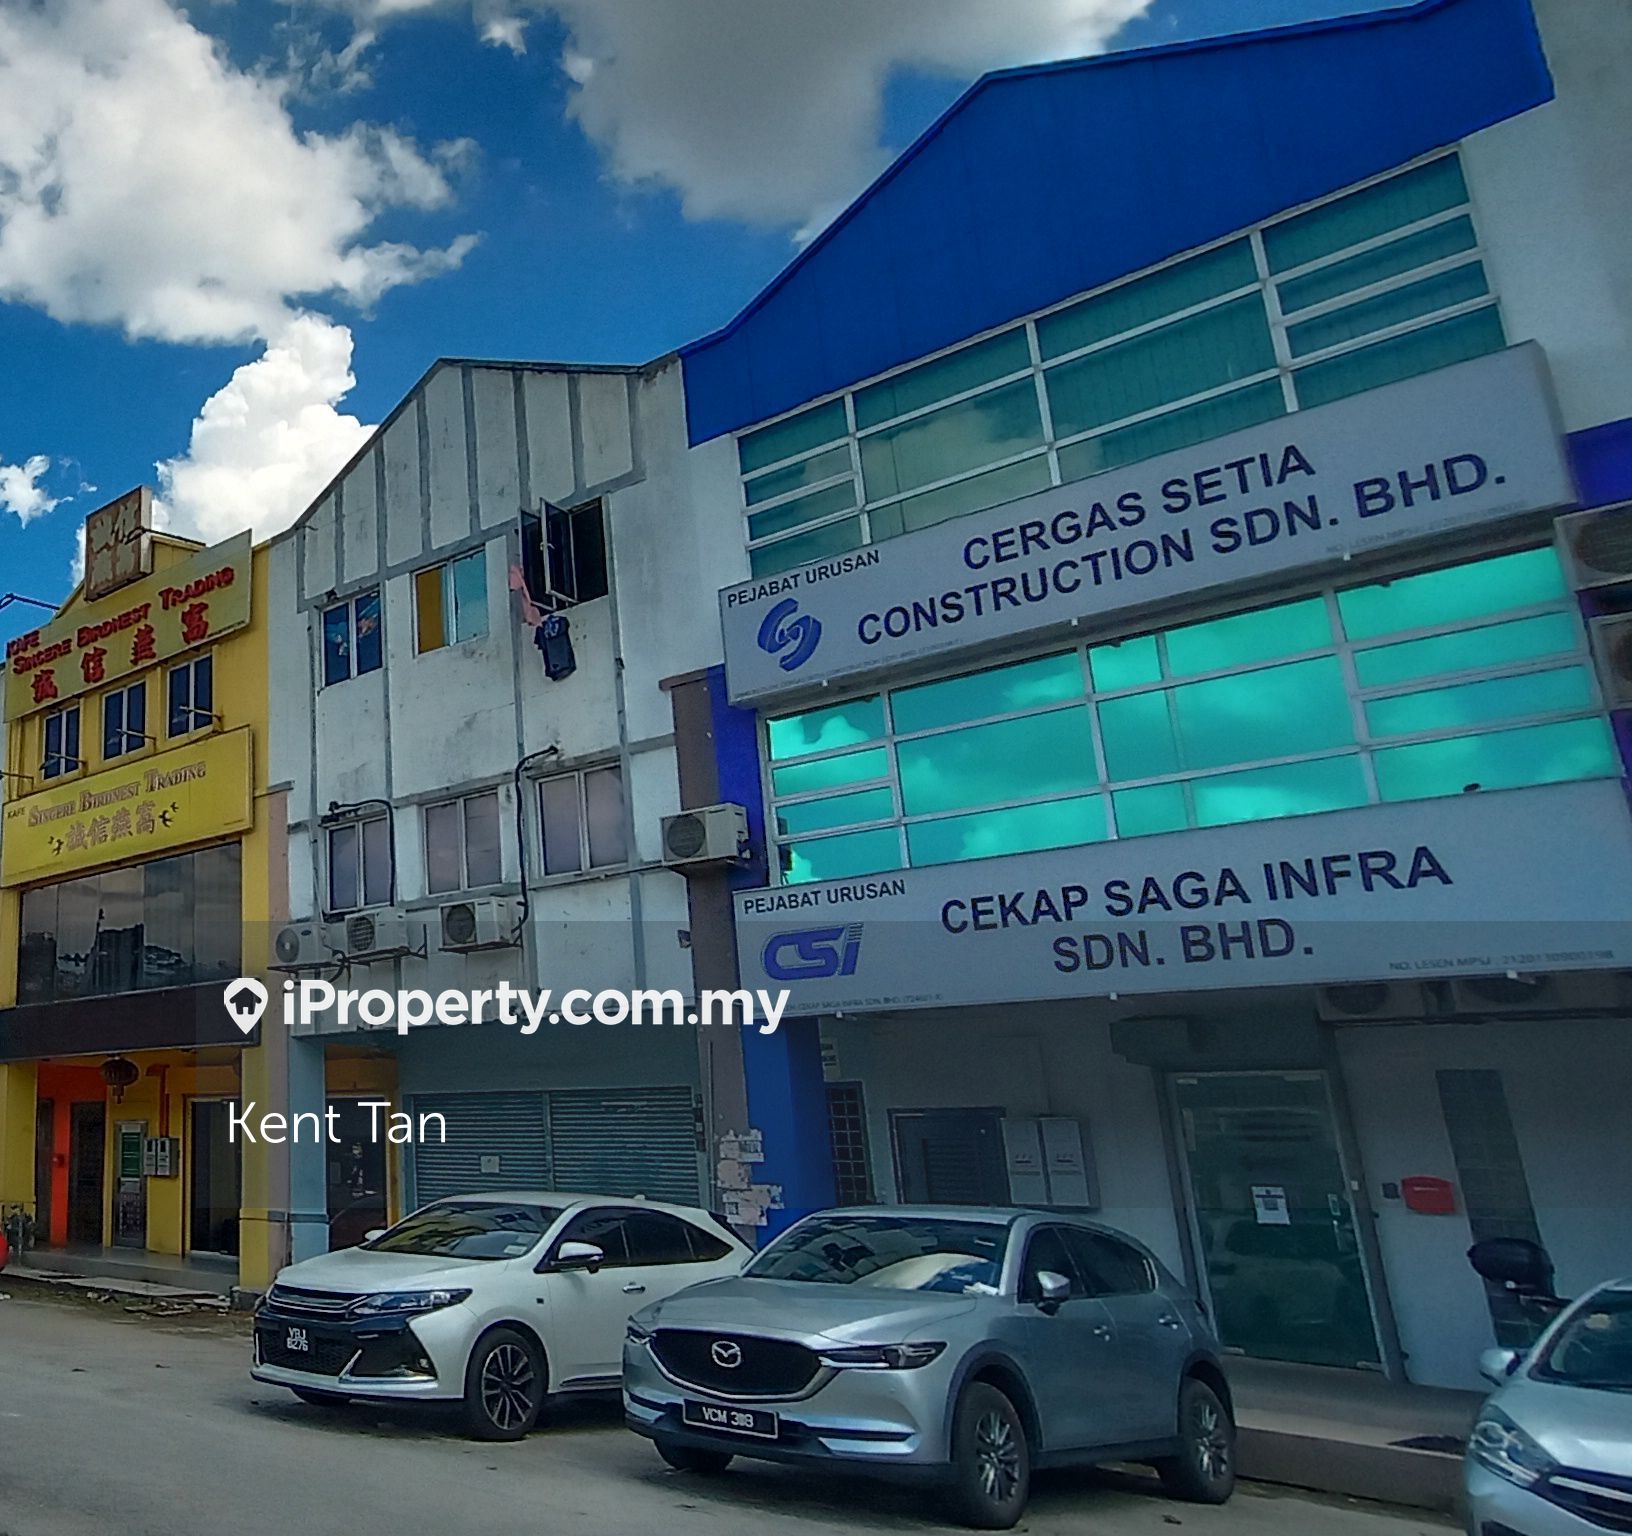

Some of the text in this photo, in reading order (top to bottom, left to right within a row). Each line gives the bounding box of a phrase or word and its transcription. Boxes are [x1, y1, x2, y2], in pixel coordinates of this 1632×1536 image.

[963, 445, 1317, 570] CERGAS SETIA
[858, 528, 1195, 645] CONSTRUCTION
[1210, 494, 1340, 554] SDN.
[1353, 453, 1507, 519] BHD.
[727, 550, 881, 608] PEJABAT URUSAN
[744, 879, 906, 914] PEJABAT URUSAN
[941, 846, 1453, 934] CEKAP SAGA INFRA
[1054, 918, 1314, 973] SDN. BHD.
[702, 1406, 728, 1424] VCM
